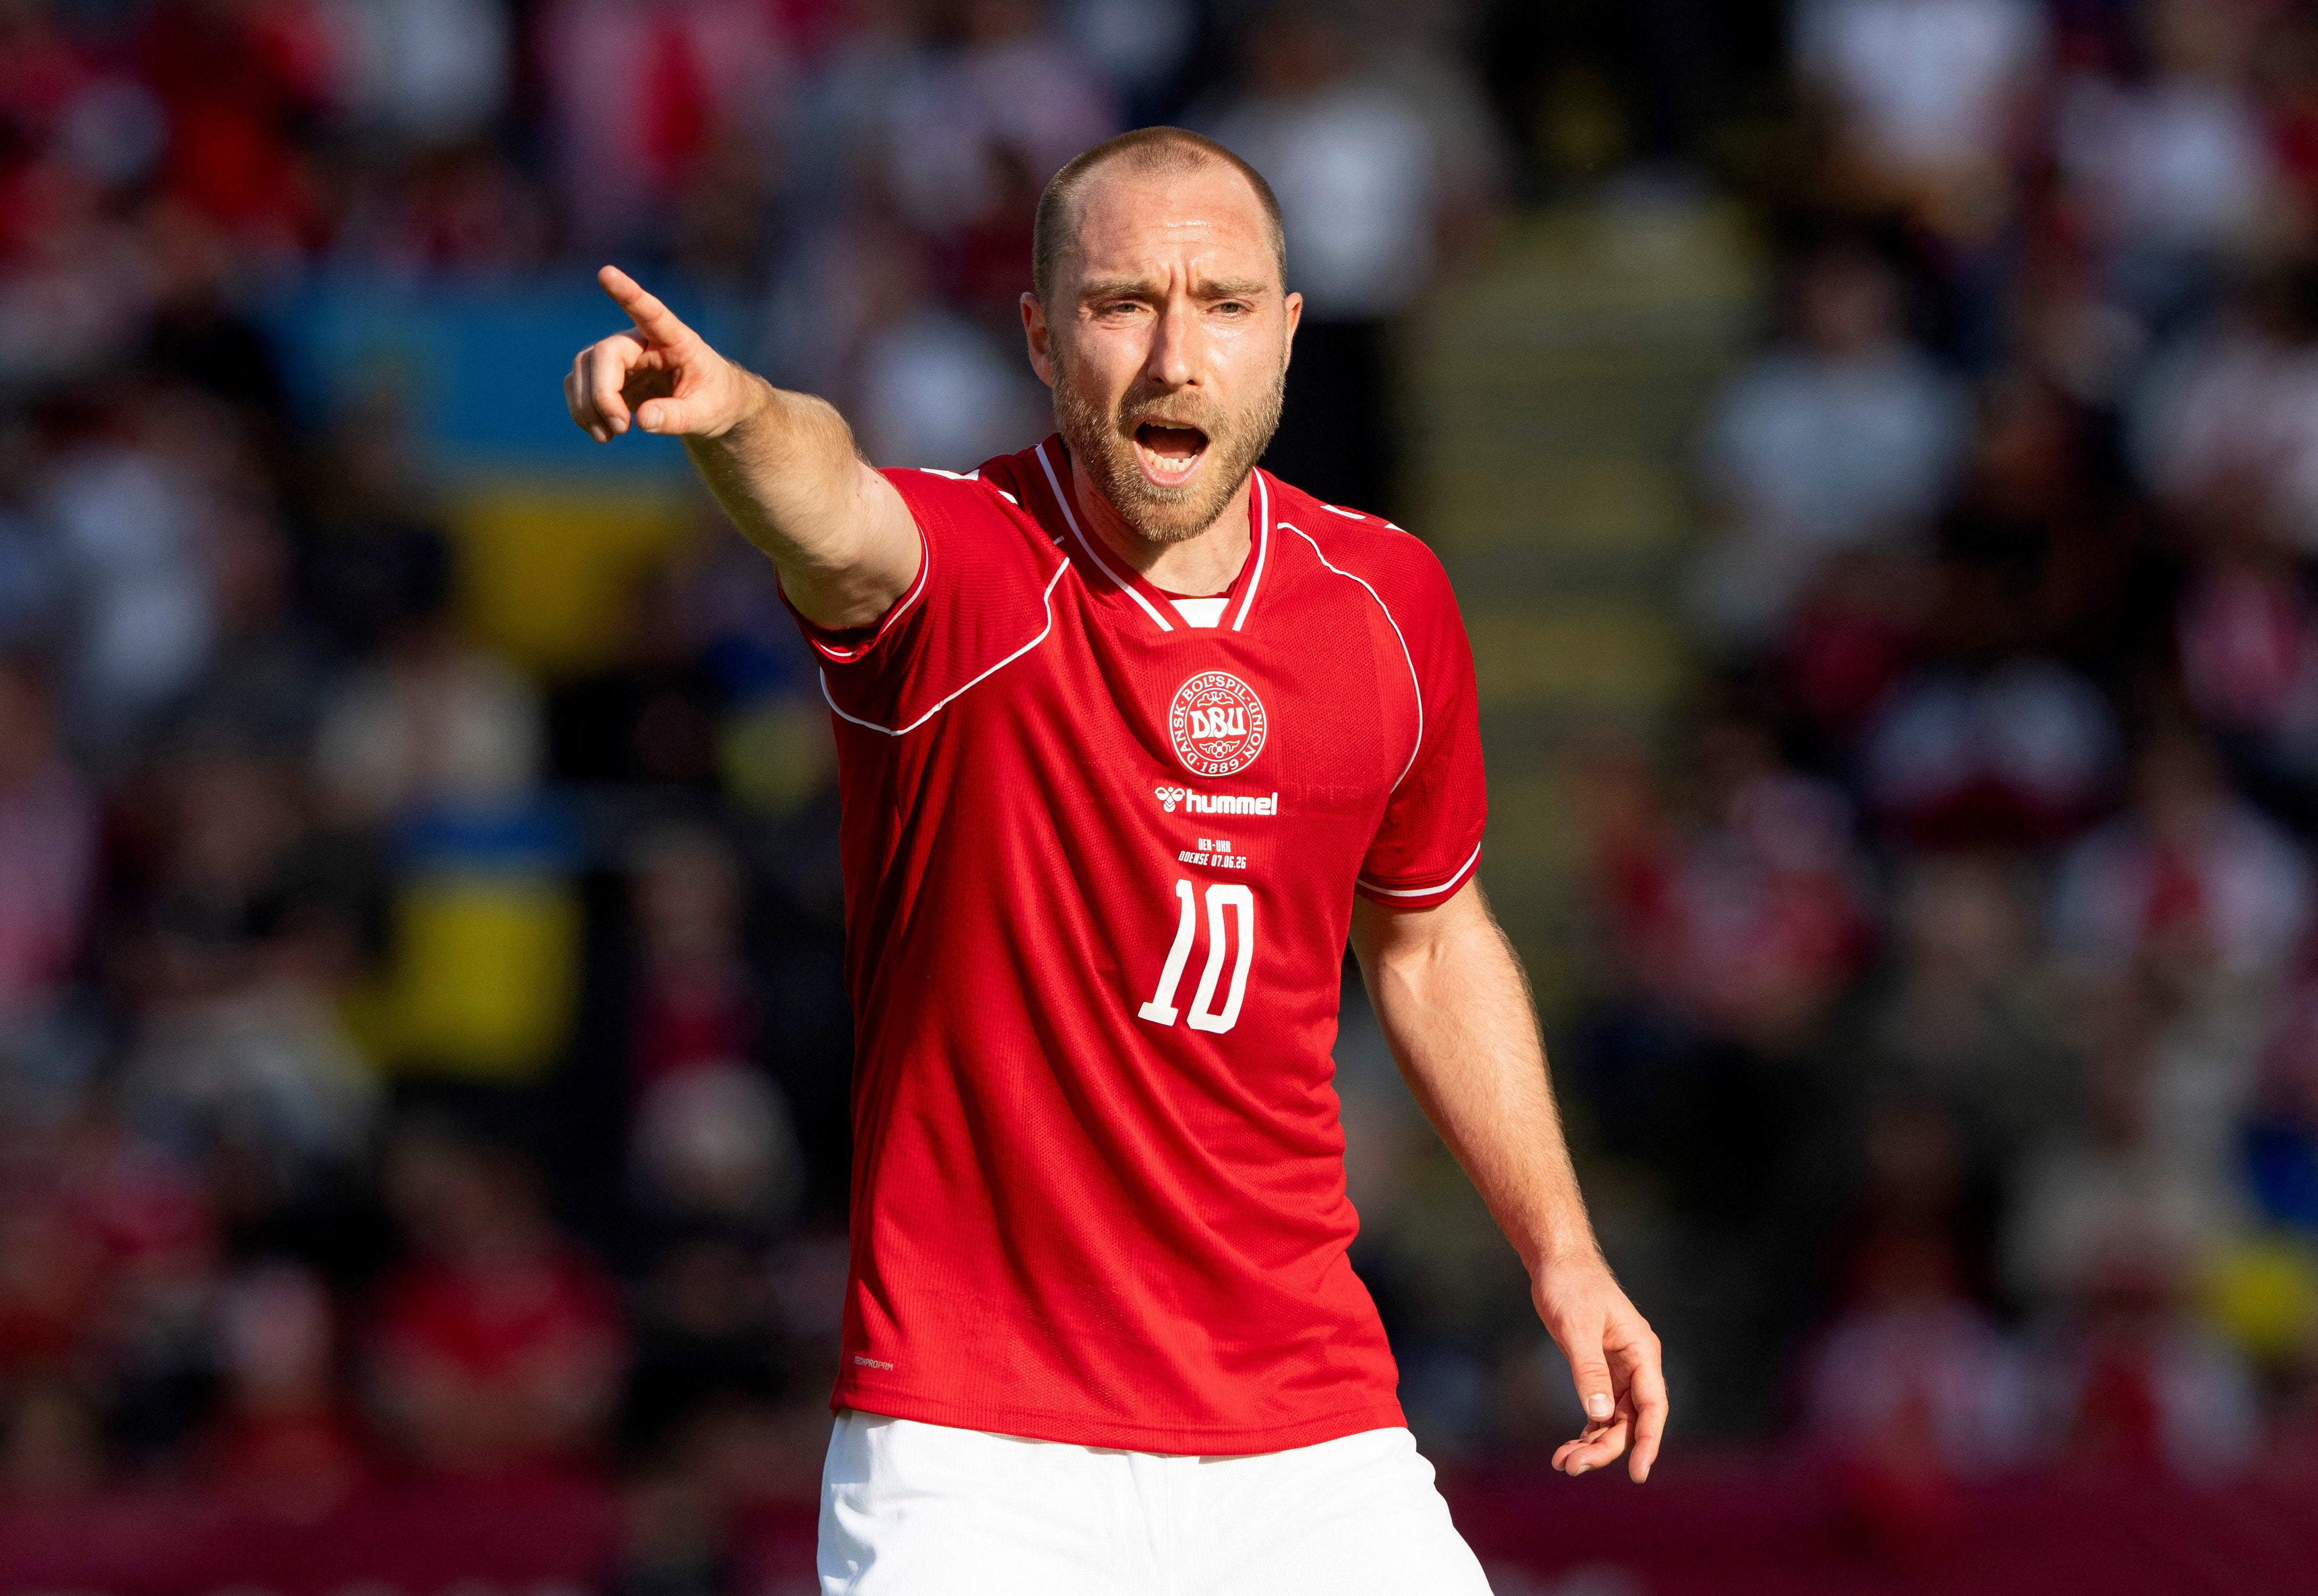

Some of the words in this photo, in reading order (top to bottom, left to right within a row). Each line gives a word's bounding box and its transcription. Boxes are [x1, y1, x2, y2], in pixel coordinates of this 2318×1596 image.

[1189, 707, 1247, 739] DBU
[1173, 703, 1199, 765] DANSK
[1200, 758, 1239, 774] 1889
[1186, 789, 1278, 816] hummel
[1178, 851, 1210, 866] ODENSE
[1210, 854, 1246, 869] 07.06.26
[1198, 838, 1231, 853] DEN-UKR
[1138, 879, 1254, 1034] 10
